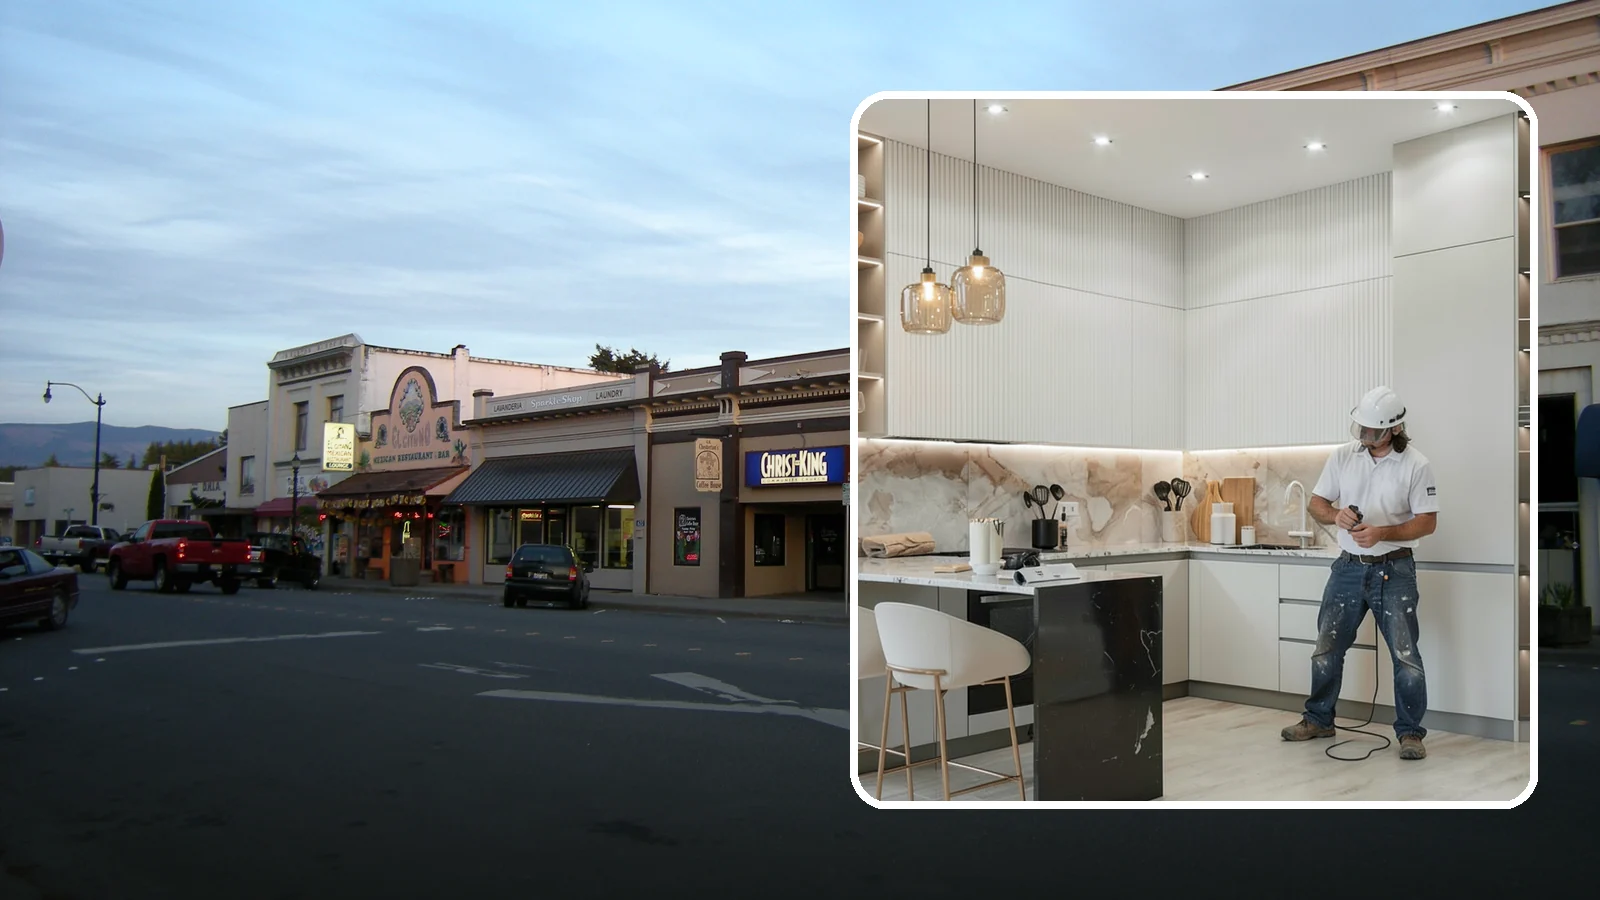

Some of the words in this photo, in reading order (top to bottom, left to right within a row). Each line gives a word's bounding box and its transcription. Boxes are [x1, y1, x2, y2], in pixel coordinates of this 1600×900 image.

[561, 394, 583, 404] Shop
[595, 389, 623, 400] LAUNDRY
[493, 402, 522, 412] LAVANDERIA
[373, 455, 396, 464] MEXICAN
[397, 451, 433, 462] RESTAURANT
[437, 450, 450, 459] BAR
[760, 452, 797, 478] CHRIST
[799, 449, 827, 476] KING
